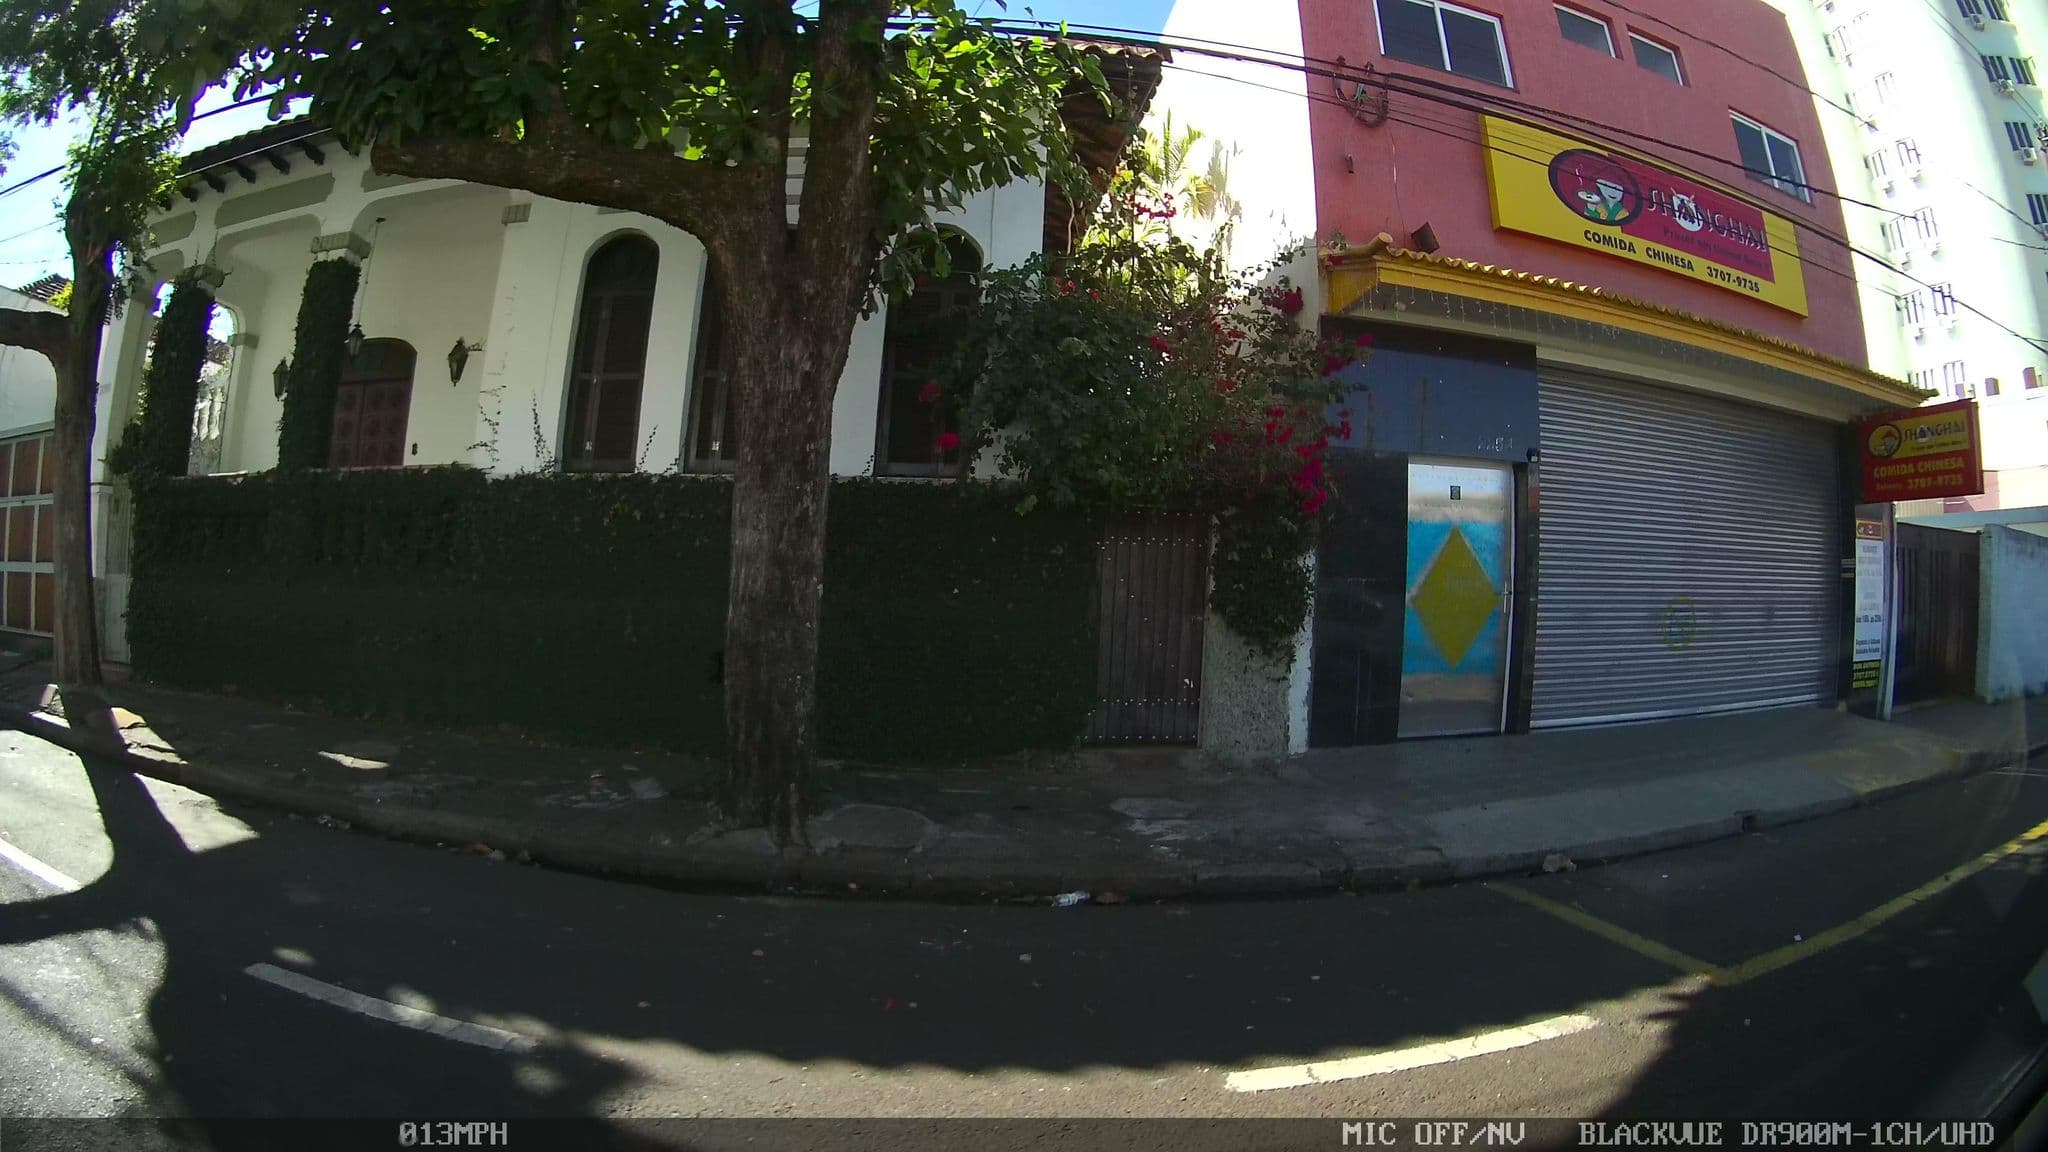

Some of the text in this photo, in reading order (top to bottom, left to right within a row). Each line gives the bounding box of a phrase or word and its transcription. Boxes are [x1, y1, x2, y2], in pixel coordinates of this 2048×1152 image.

[1647, 188, 1767, 252] SHANGHAI
[1584, 229, 1637, 254] COMIDA
[1646, 247, 1695, 273] CHINESA
[1706, 265, 1760, 293] 3707-9735
[1903, 420, 1965, 442] SHANGHAI
[1873, 457, 1965, 479] COMIDA CHINESA
